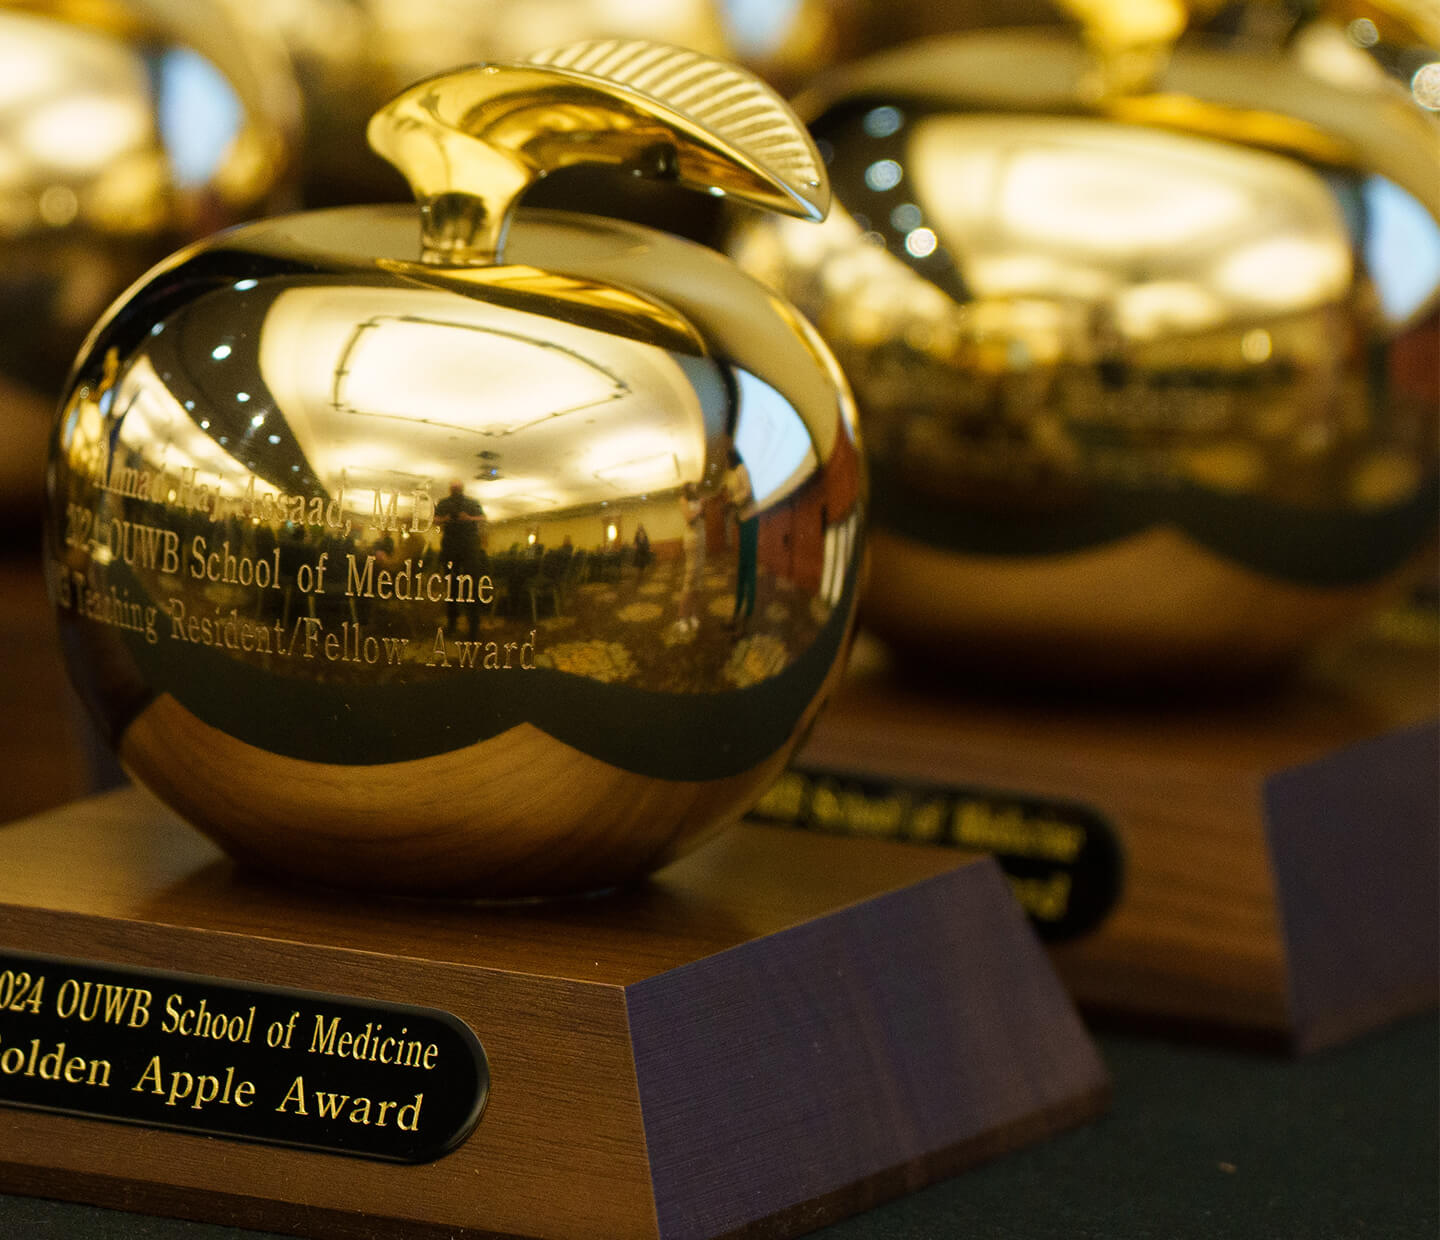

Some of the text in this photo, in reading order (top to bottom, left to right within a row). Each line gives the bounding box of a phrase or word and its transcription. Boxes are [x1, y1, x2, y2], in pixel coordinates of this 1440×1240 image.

[107, 518, 180, 575] OUWB
[189, 535, 282, 590] School
[296, 551, 329, 595] of
[344, 553, 495, 605] Medicine
[168, 597, 409, 668] Resident/Fellow
[425, 627, 539, 672] Award
[55, 978, 153, 1029] OUWB
[160, 991, 257, 1045] School
[266, 1011, 300, 1050] of
[310, 1013, 440, 1071] Medicine
[131, 1055, 257, 1111] Apple
[275, 1075, 424, 1133] Award
